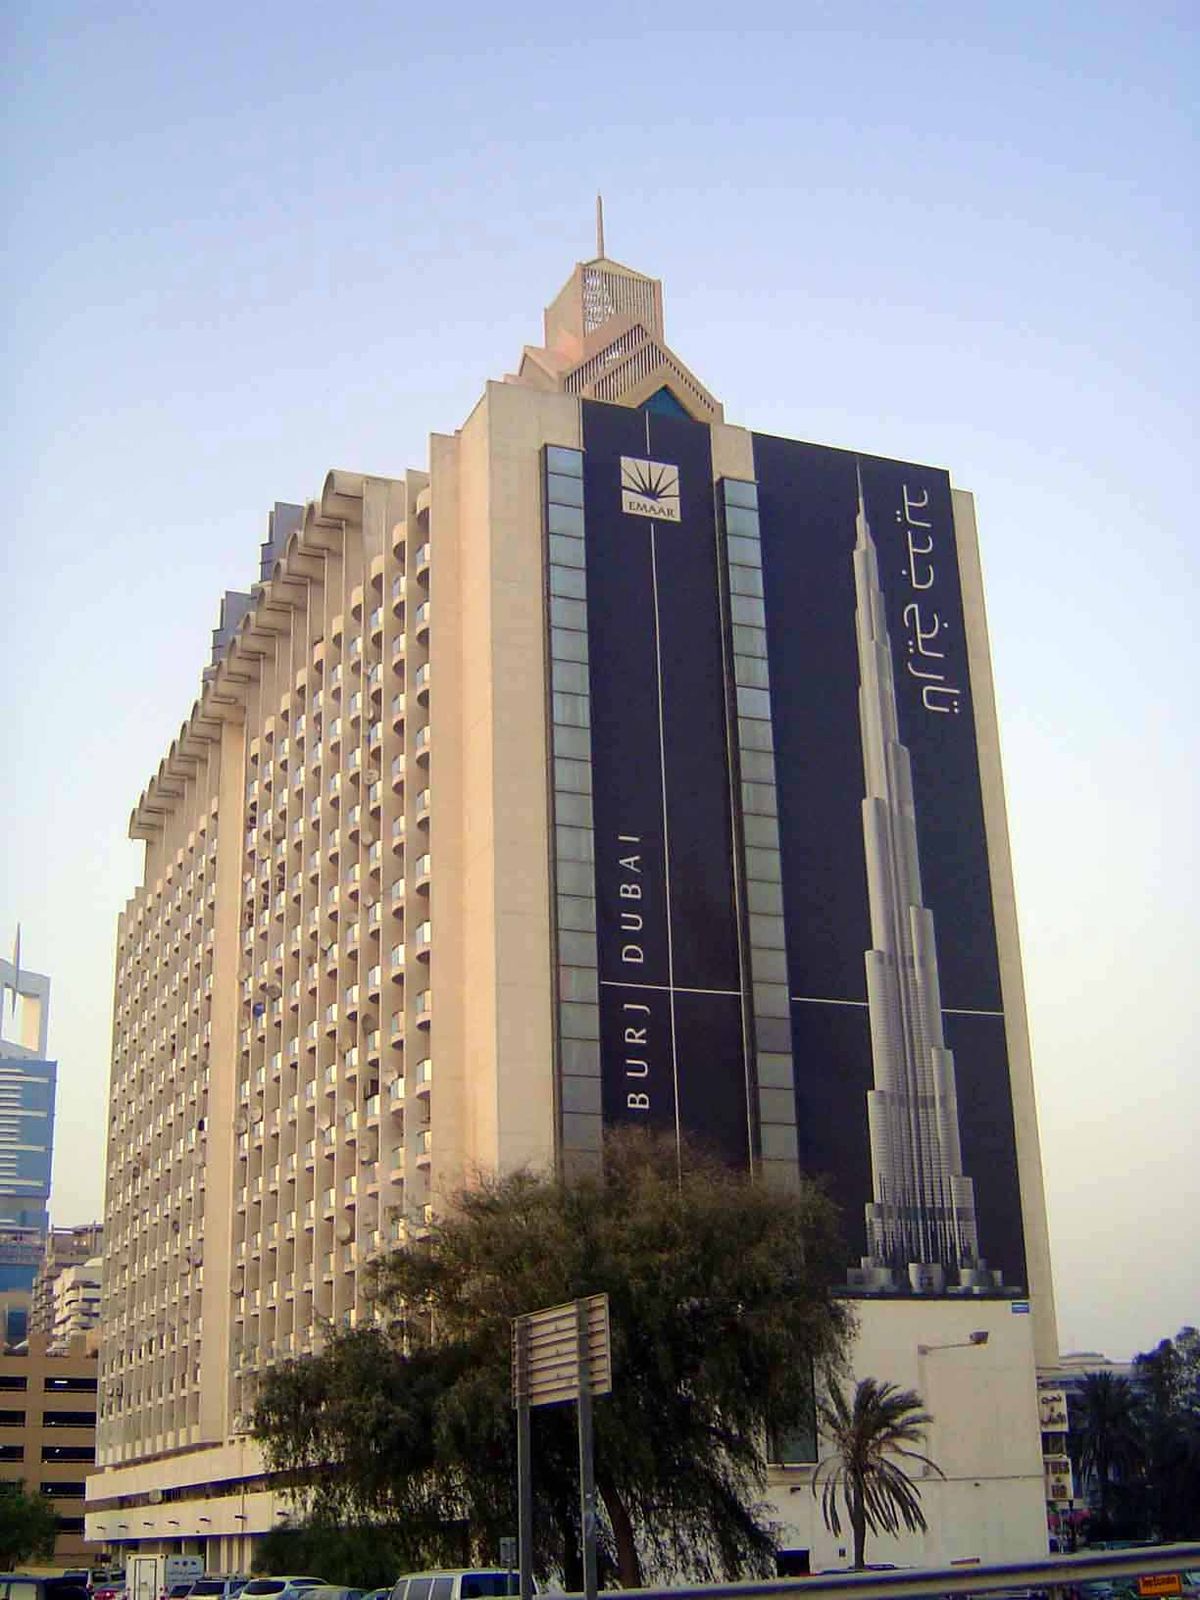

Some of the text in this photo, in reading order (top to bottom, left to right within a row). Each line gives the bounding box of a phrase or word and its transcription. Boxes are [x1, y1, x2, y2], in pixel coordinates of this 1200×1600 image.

[628, 501, 675, 518] EMAAR
[895, 484, 961, 714] تاريخ جديد
[617, 834, 651, 1111] BURJ DUBAI
